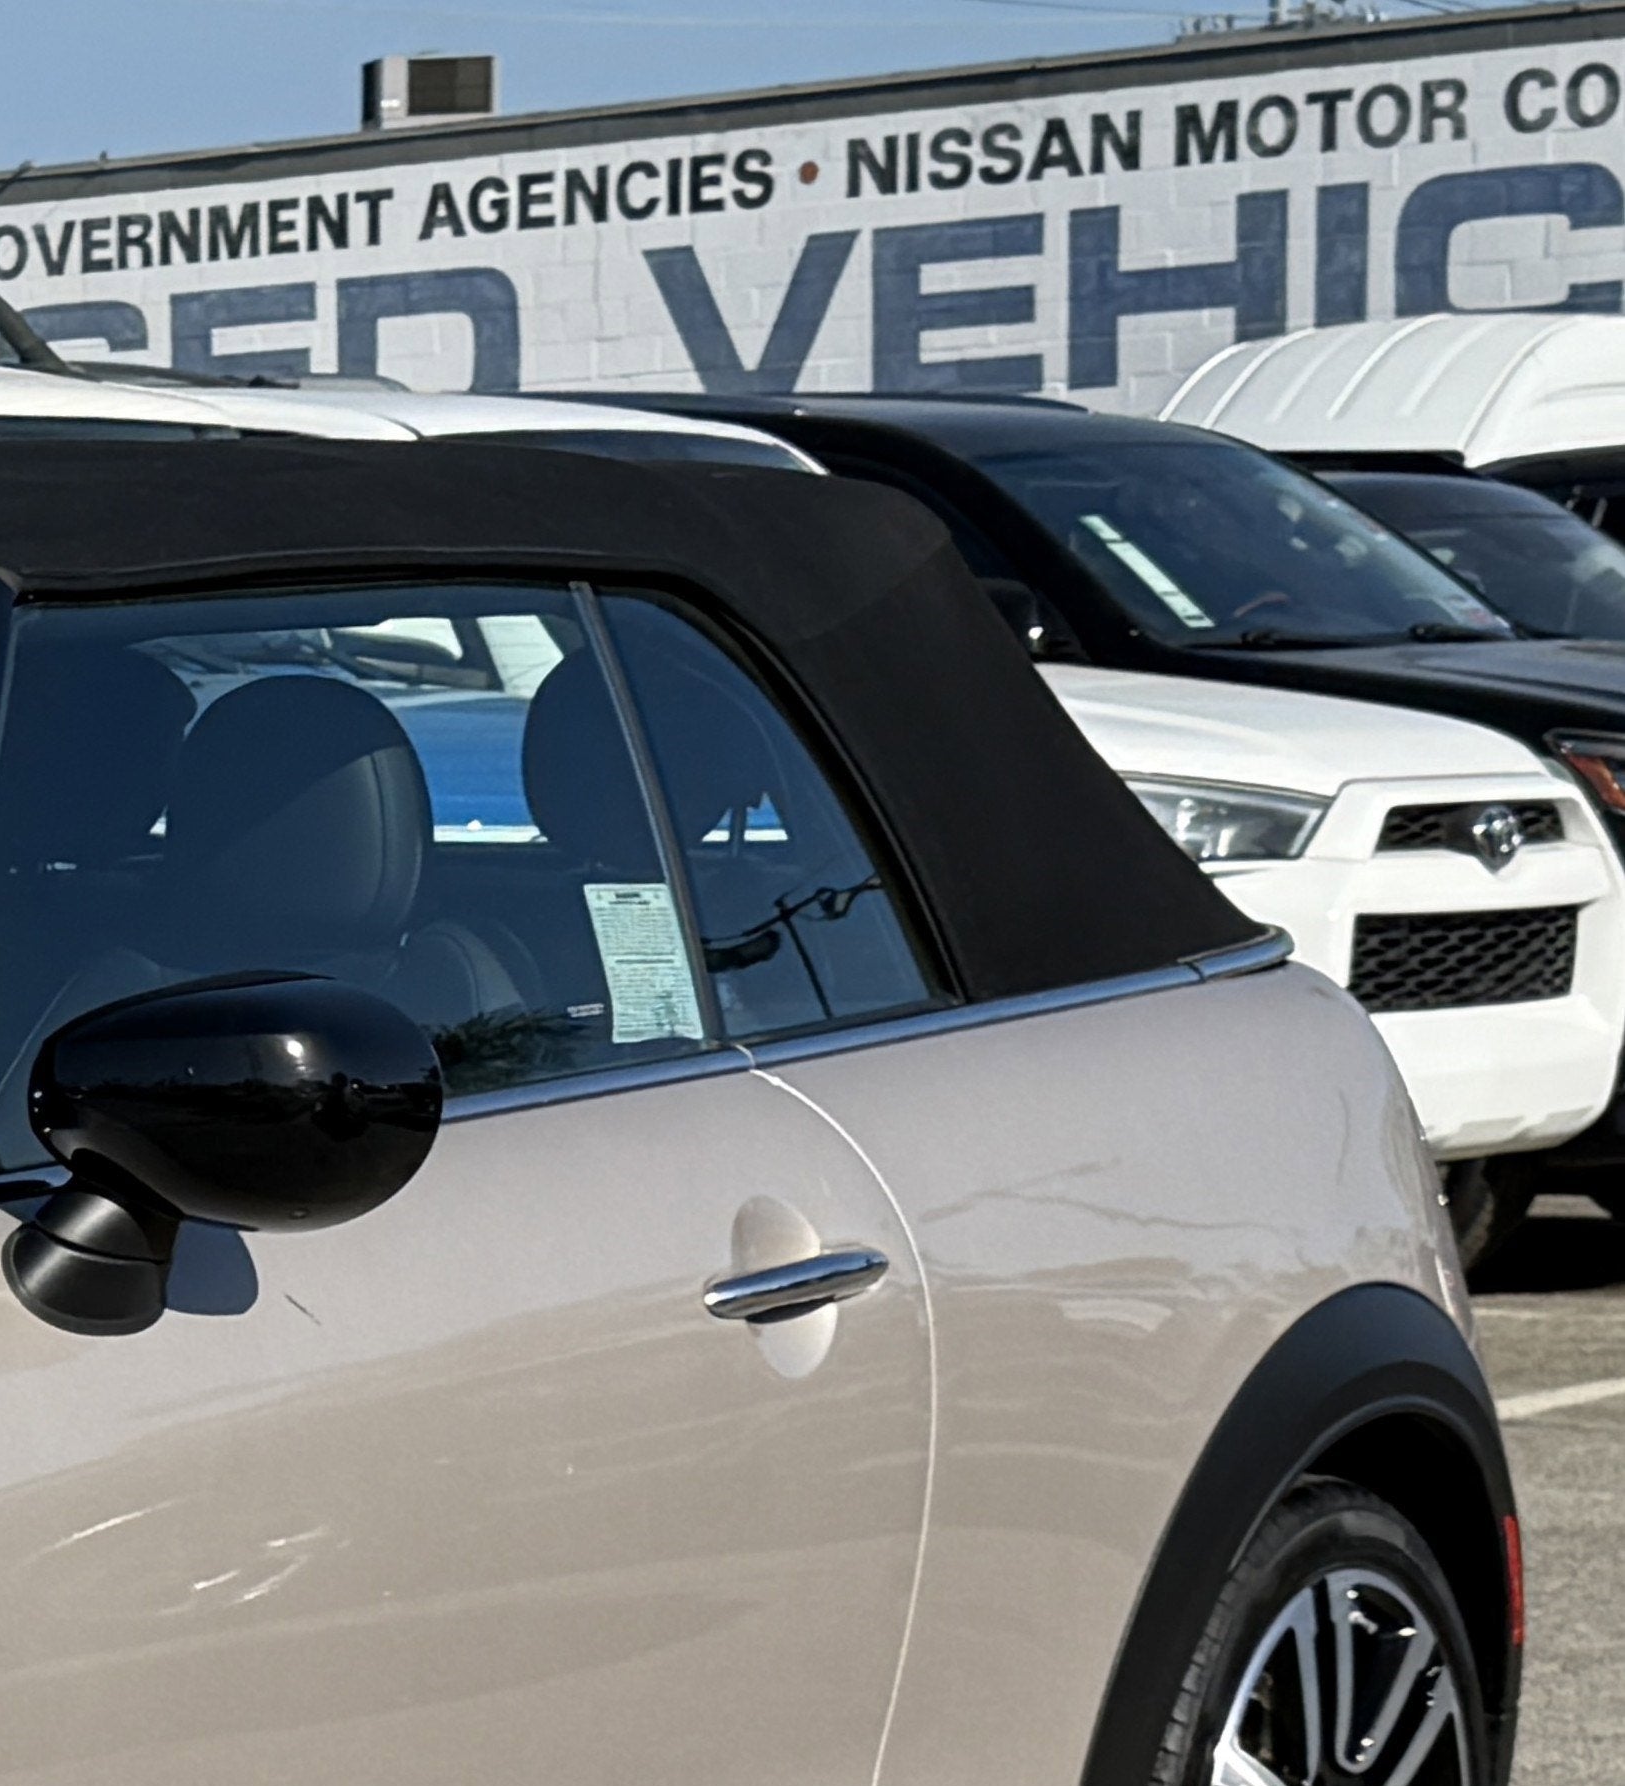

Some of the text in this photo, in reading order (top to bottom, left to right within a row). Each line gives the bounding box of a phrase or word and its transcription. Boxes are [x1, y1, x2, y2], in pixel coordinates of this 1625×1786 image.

[418, 148, 774, 241] AGENCIES
[846, 109, 1143, 198] NISSAN
[1174, 77, 1469, 167] MOTOR
[1503, 61, 1622, 134] CO
[643, 162, 1625, 396] VEHIC
